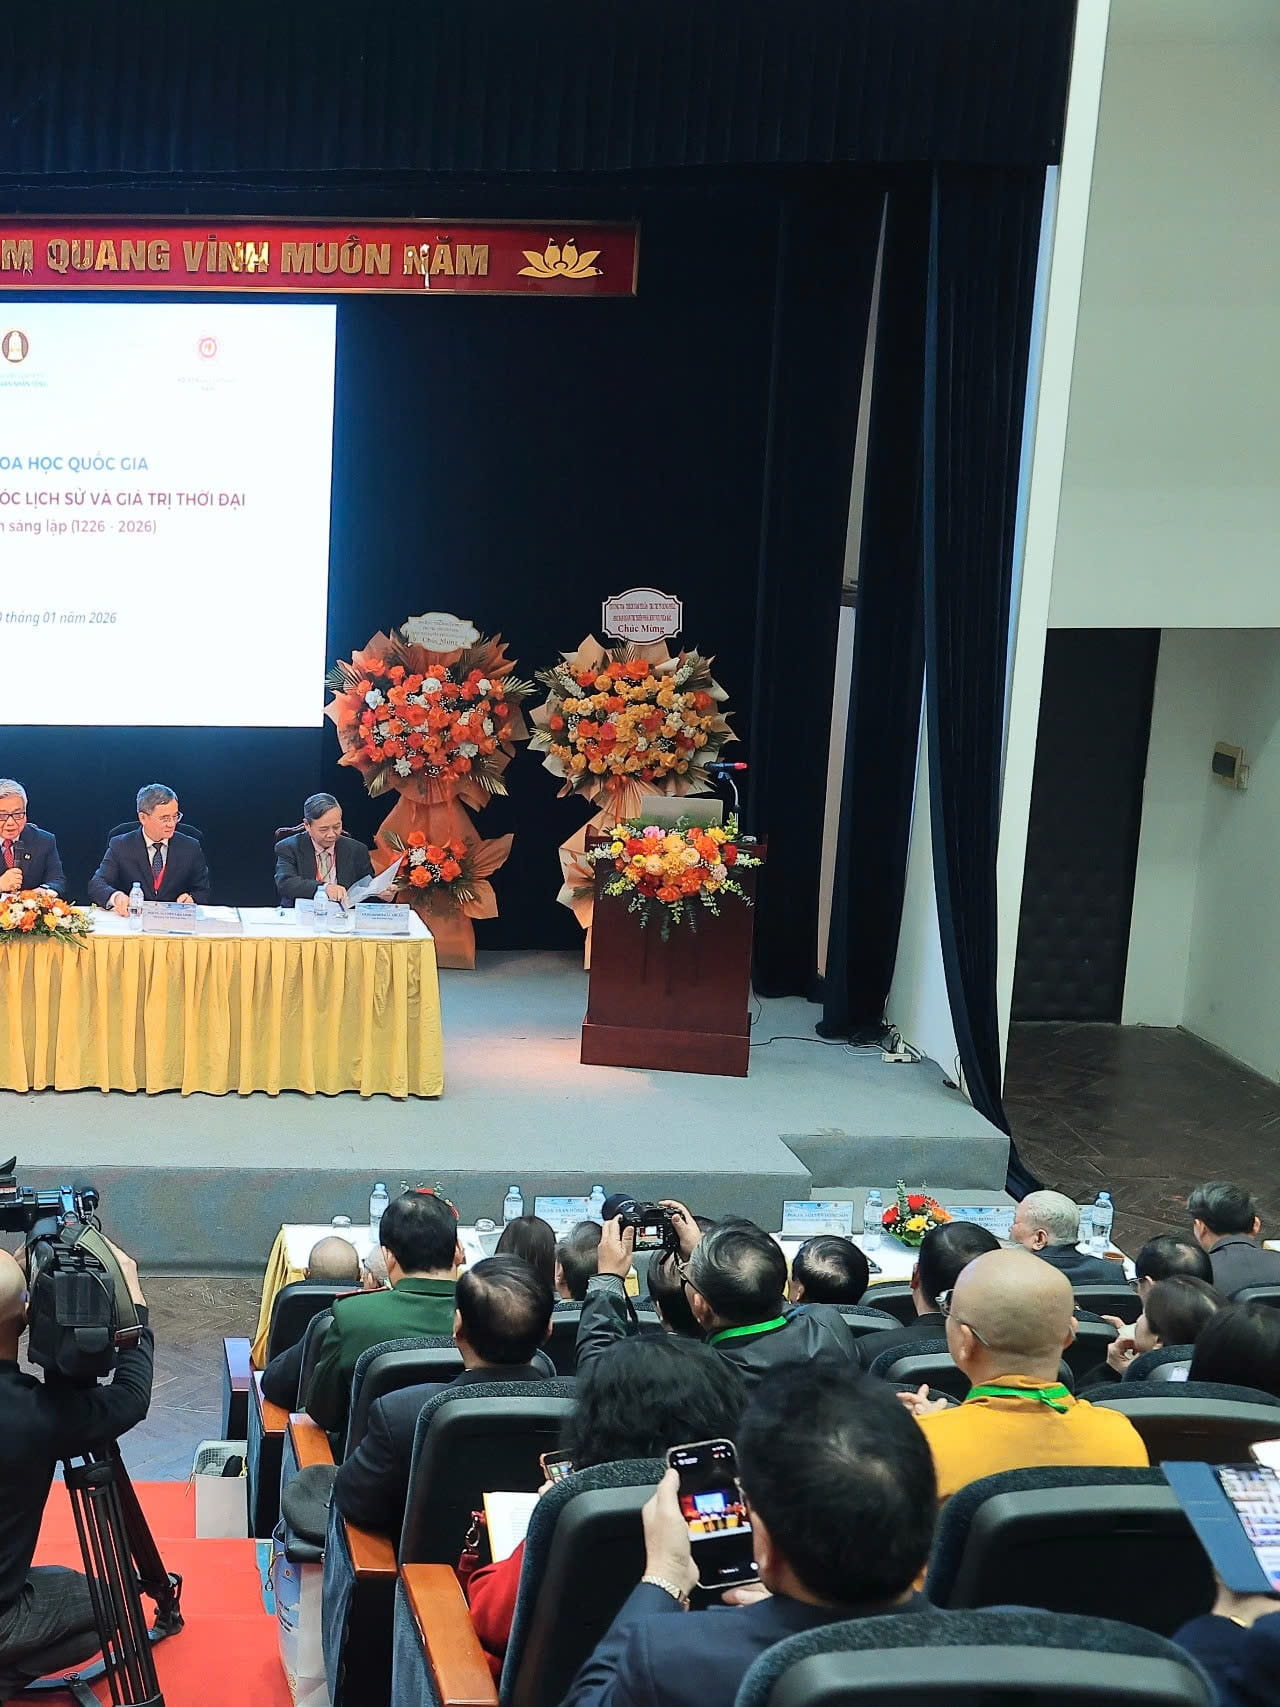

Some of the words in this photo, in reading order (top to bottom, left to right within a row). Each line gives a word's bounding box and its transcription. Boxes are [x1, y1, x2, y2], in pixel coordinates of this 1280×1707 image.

[47, 238, 170, 274] QUANG
[280, 234, 391, 275] MUÔN
[403, 235, 489, 276] NĂM
[28, 456, 64, 475] HỌC
[67, 450, 116, 474] QUỐC
[120, 457, 149, 472] GIA
[25, 491, 60, 510] LỊCH
[64, 486, 87, 506] SỬ
[90, 488, 112, 506] VÀ
[116, 488, 143, 507] GIÁ
[148, 492, 171, 511] TRỊ
[176, 488, 214, 507] THỜI
[218, 492, 245, 511] ĐẠI
[8, 518, 42, 535] sáng
[46, 519, 68, 537] lập
[71, 519, 105, 535] (1226
[118, 520, 157, 536] 2026)
[5, 610, 40, 627] tháng
[42, 611, 57, 623] 01
[59, 611, 86, 624] năm
[88, 611, 118, 625] 2026
